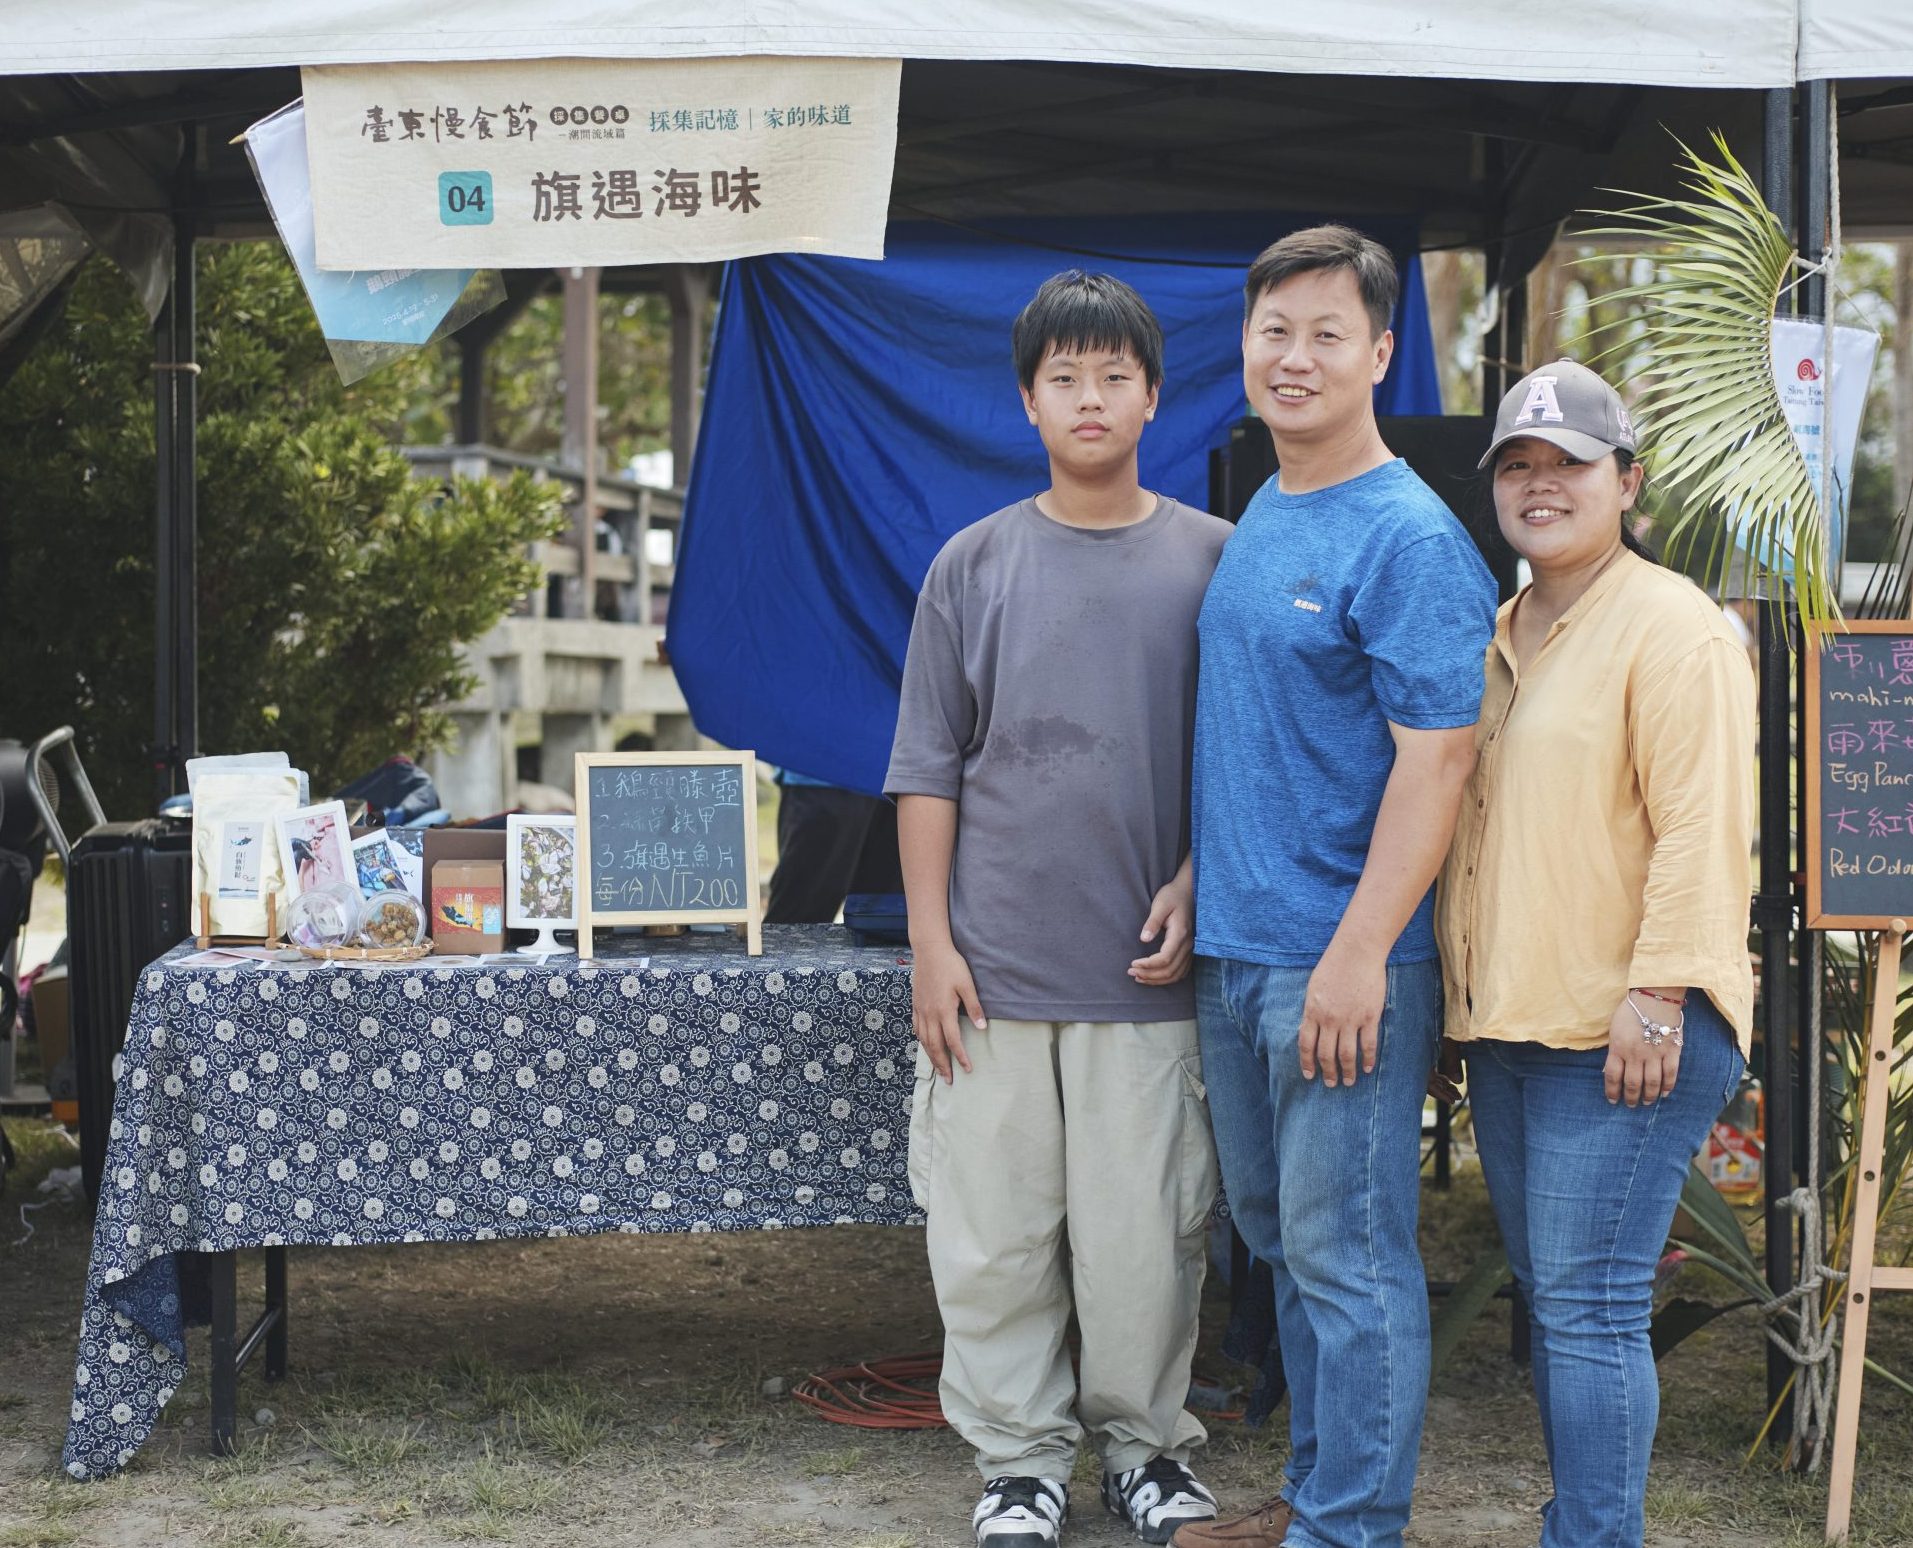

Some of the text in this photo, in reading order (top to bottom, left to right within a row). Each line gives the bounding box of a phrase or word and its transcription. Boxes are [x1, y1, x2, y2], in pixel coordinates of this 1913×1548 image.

[361, 101, 537, 143] 臺東慢食節
[650, 109, 739, 132] 採集記憶
[763, 104, 852, 129] 家的味道
[447, 184, 486, 213] 04
[531, 166, 762, 223] 旗遇海味
[1515, 376, 1563, 426] A
[1808, 387, 1825, 397] Foo
[1827, 762, 1869, 793] Egg
[1830, 847, 1860, 878] Red
